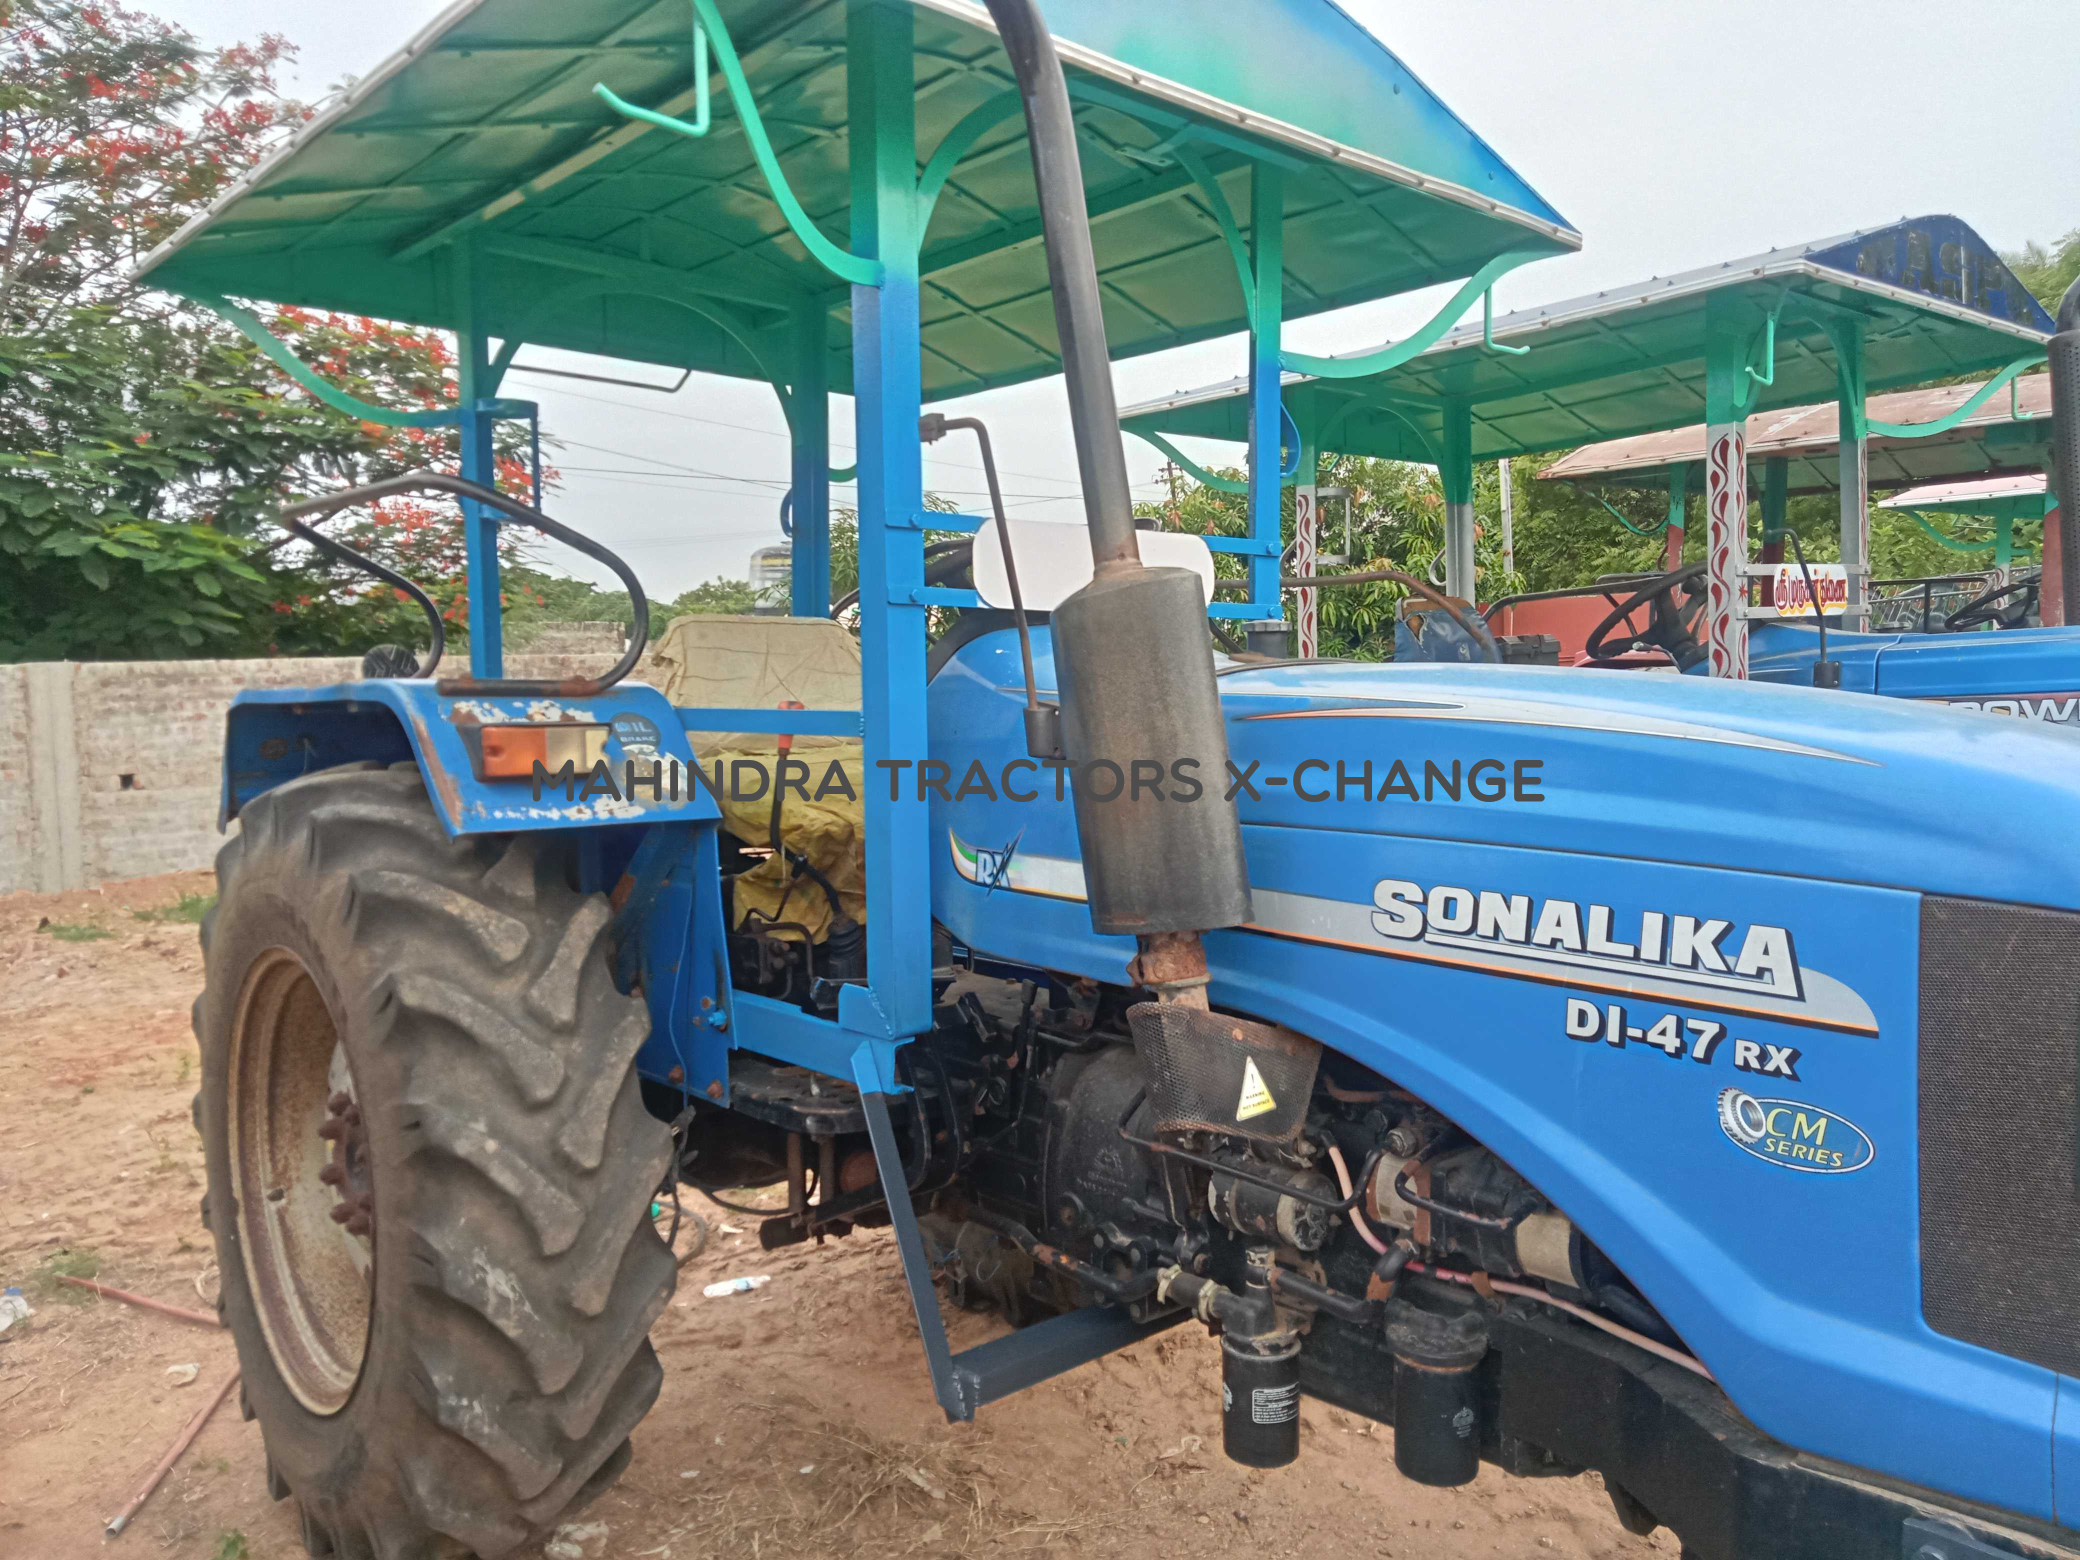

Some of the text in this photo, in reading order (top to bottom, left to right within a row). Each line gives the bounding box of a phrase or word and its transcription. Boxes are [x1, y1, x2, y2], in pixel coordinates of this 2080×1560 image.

[975, 834, 1018, 893] RX
[1369, 878, 1806, 1002] SONALIKA
[1566, 997, 1802, 1082] DI-47 RX
[1763, 1138, 1843, 1167] SERIES
[1766, 1108, 1828, 1146] CM
